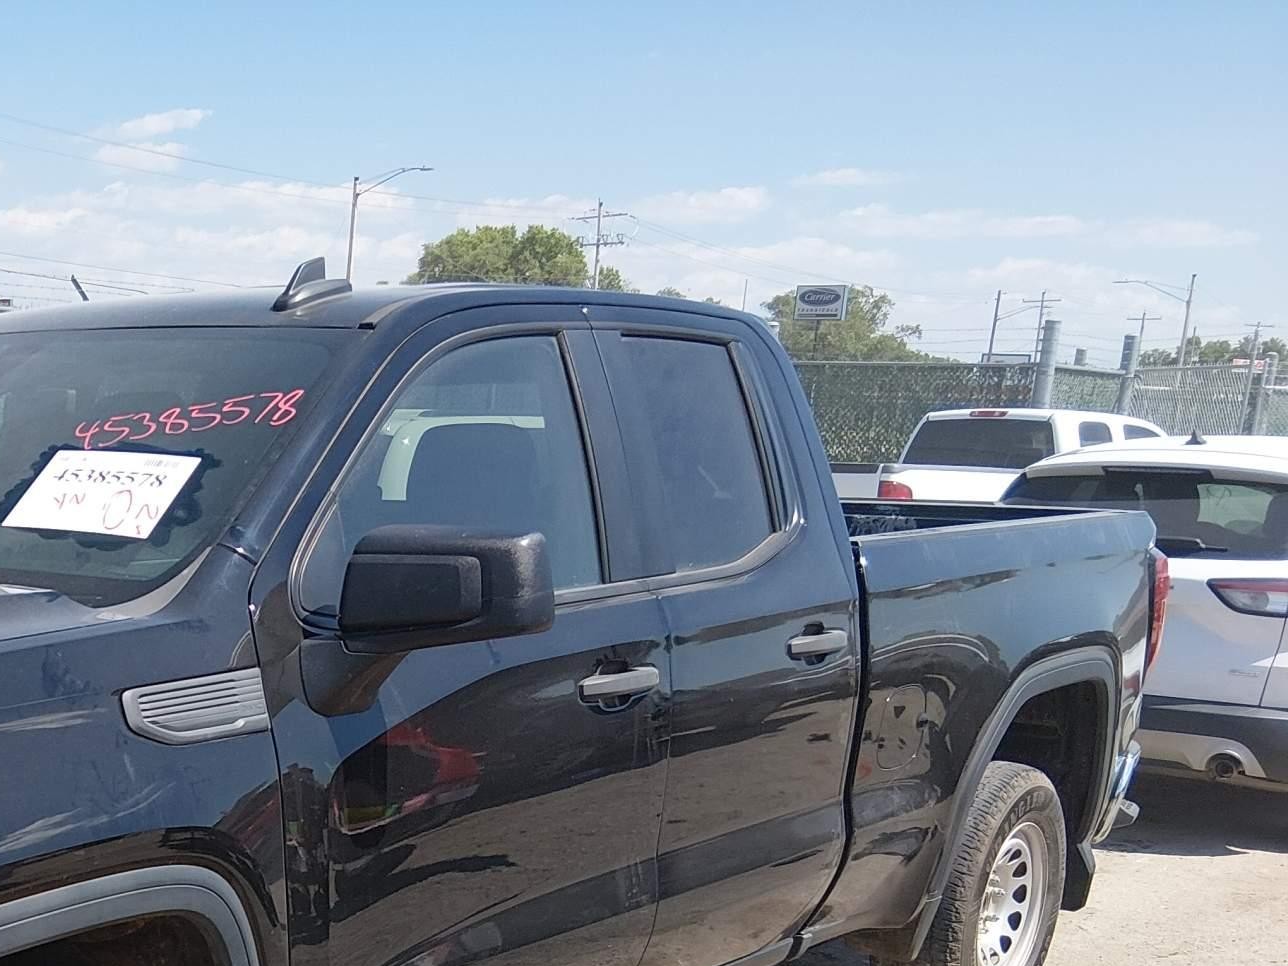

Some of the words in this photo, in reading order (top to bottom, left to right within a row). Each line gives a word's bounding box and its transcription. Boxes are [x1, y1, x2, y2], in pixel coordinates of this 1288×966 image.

[805, 292, 836, 301] Carrier
[75, 389, 305, 450] 45385578
[53, 468, 168, 488] 45385578
